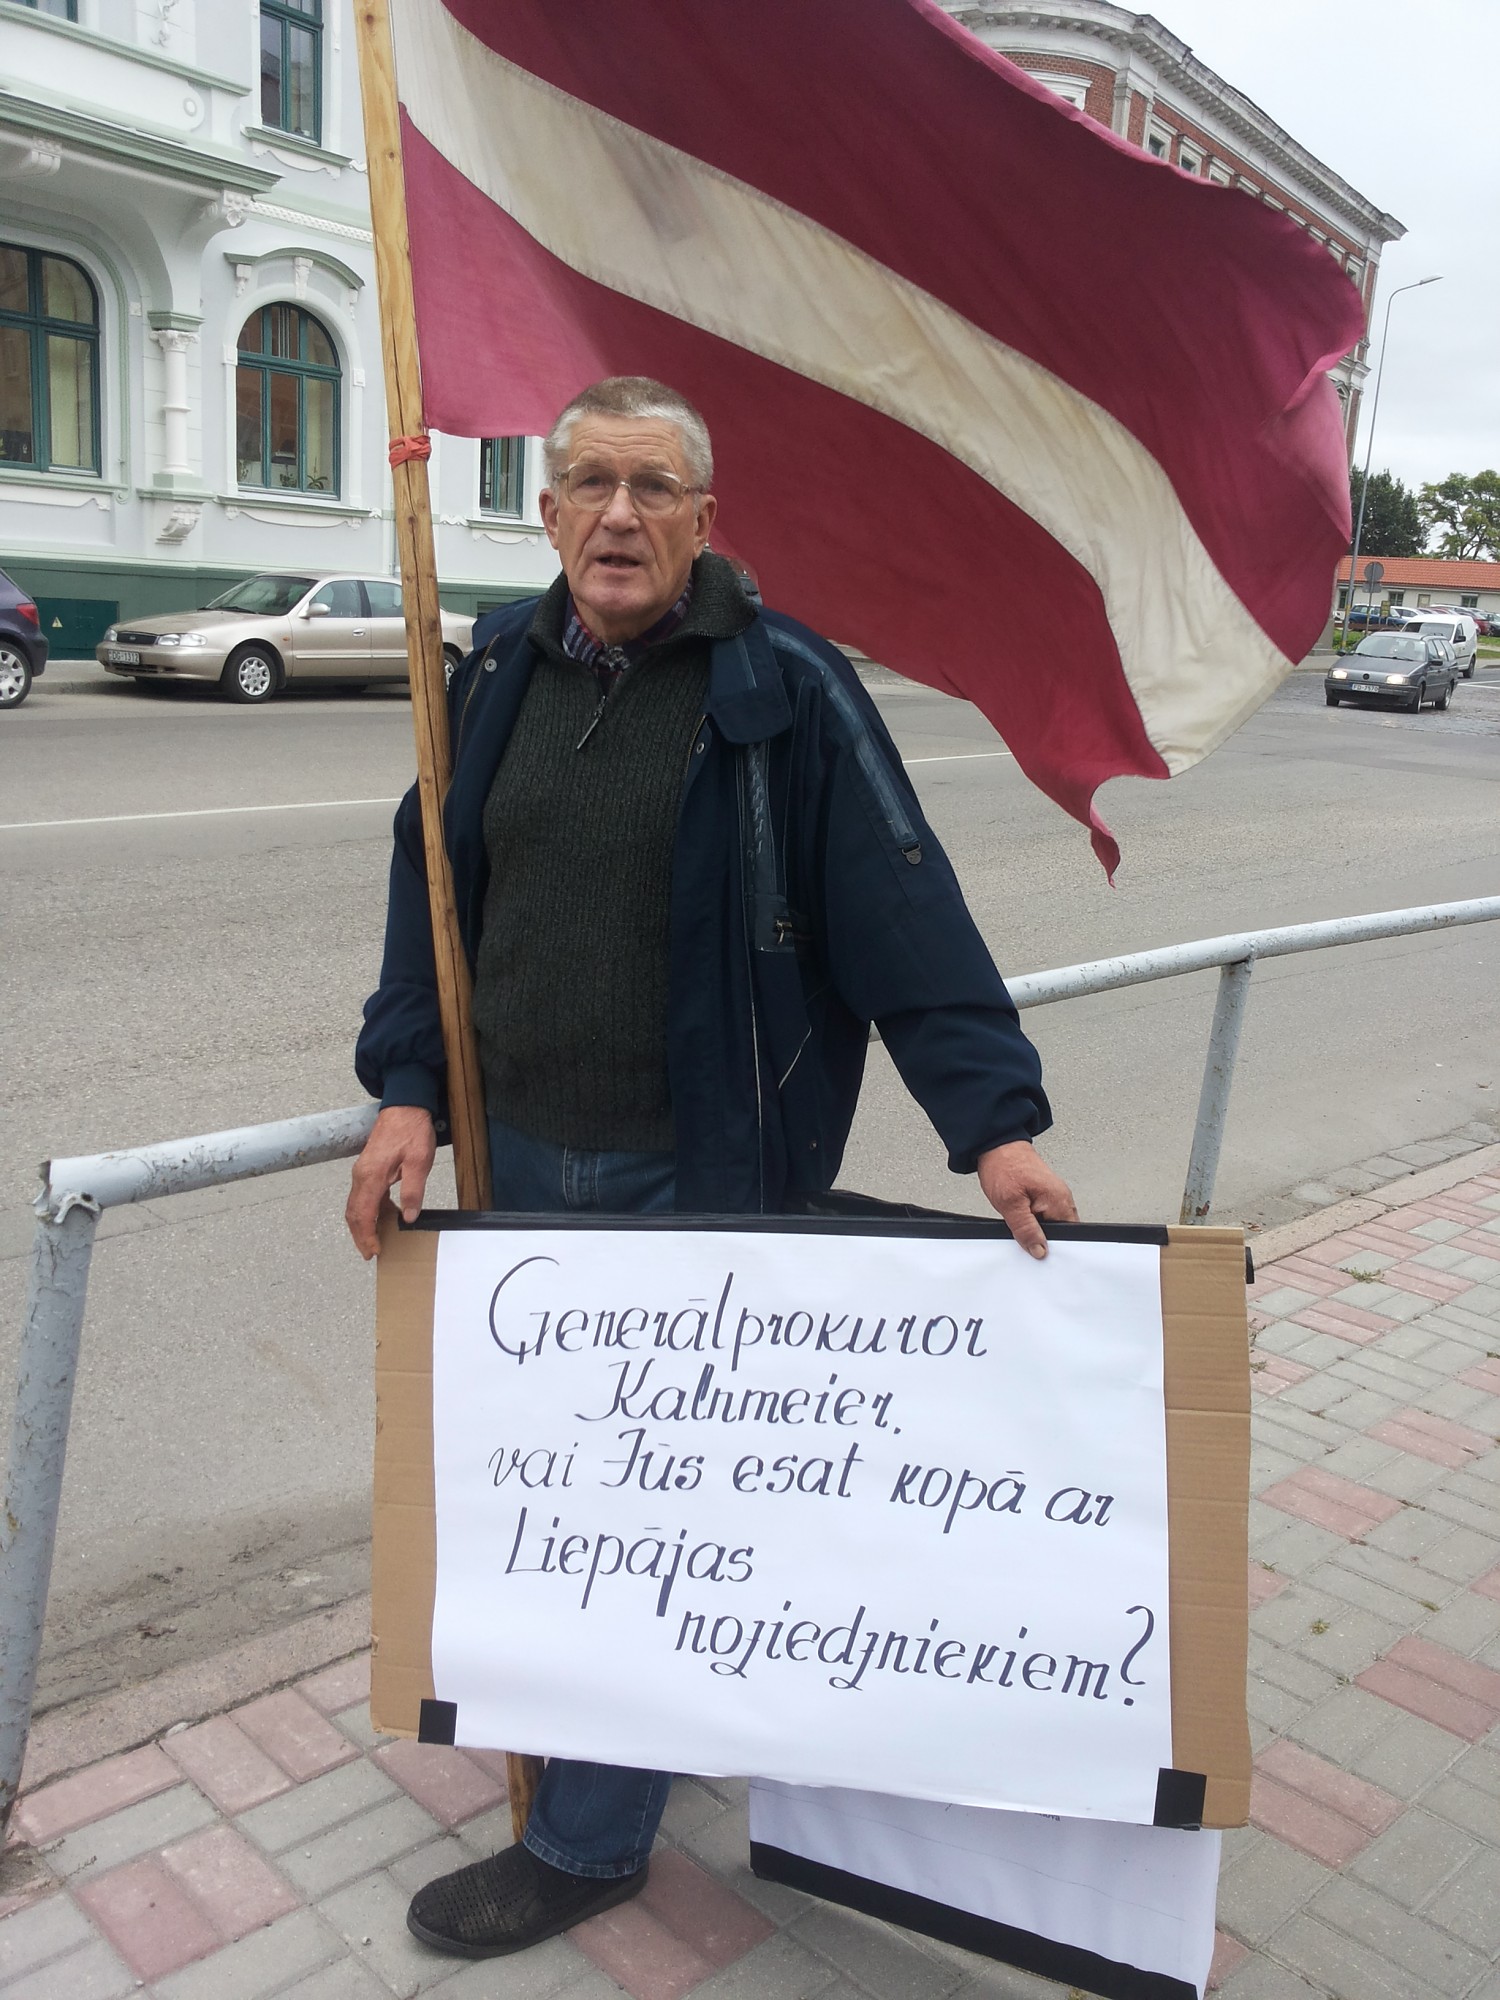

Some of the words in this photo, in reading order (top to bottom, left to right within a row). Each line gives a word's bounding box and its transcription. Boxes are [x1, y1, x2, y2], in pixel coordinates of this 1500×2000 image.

[488, 1255, 988, 1372] Generālprokuror
[487, 1441, 579, 1489] vai
[599, 1427, 705, 1492] Jūs
[732, 1441, 865, 1498] esat
[889, 1463, 1027, 1535] kopā
[1044, 1486, 1115, 1527] ar
[504, 1506, 755, 1618] Liepājas
